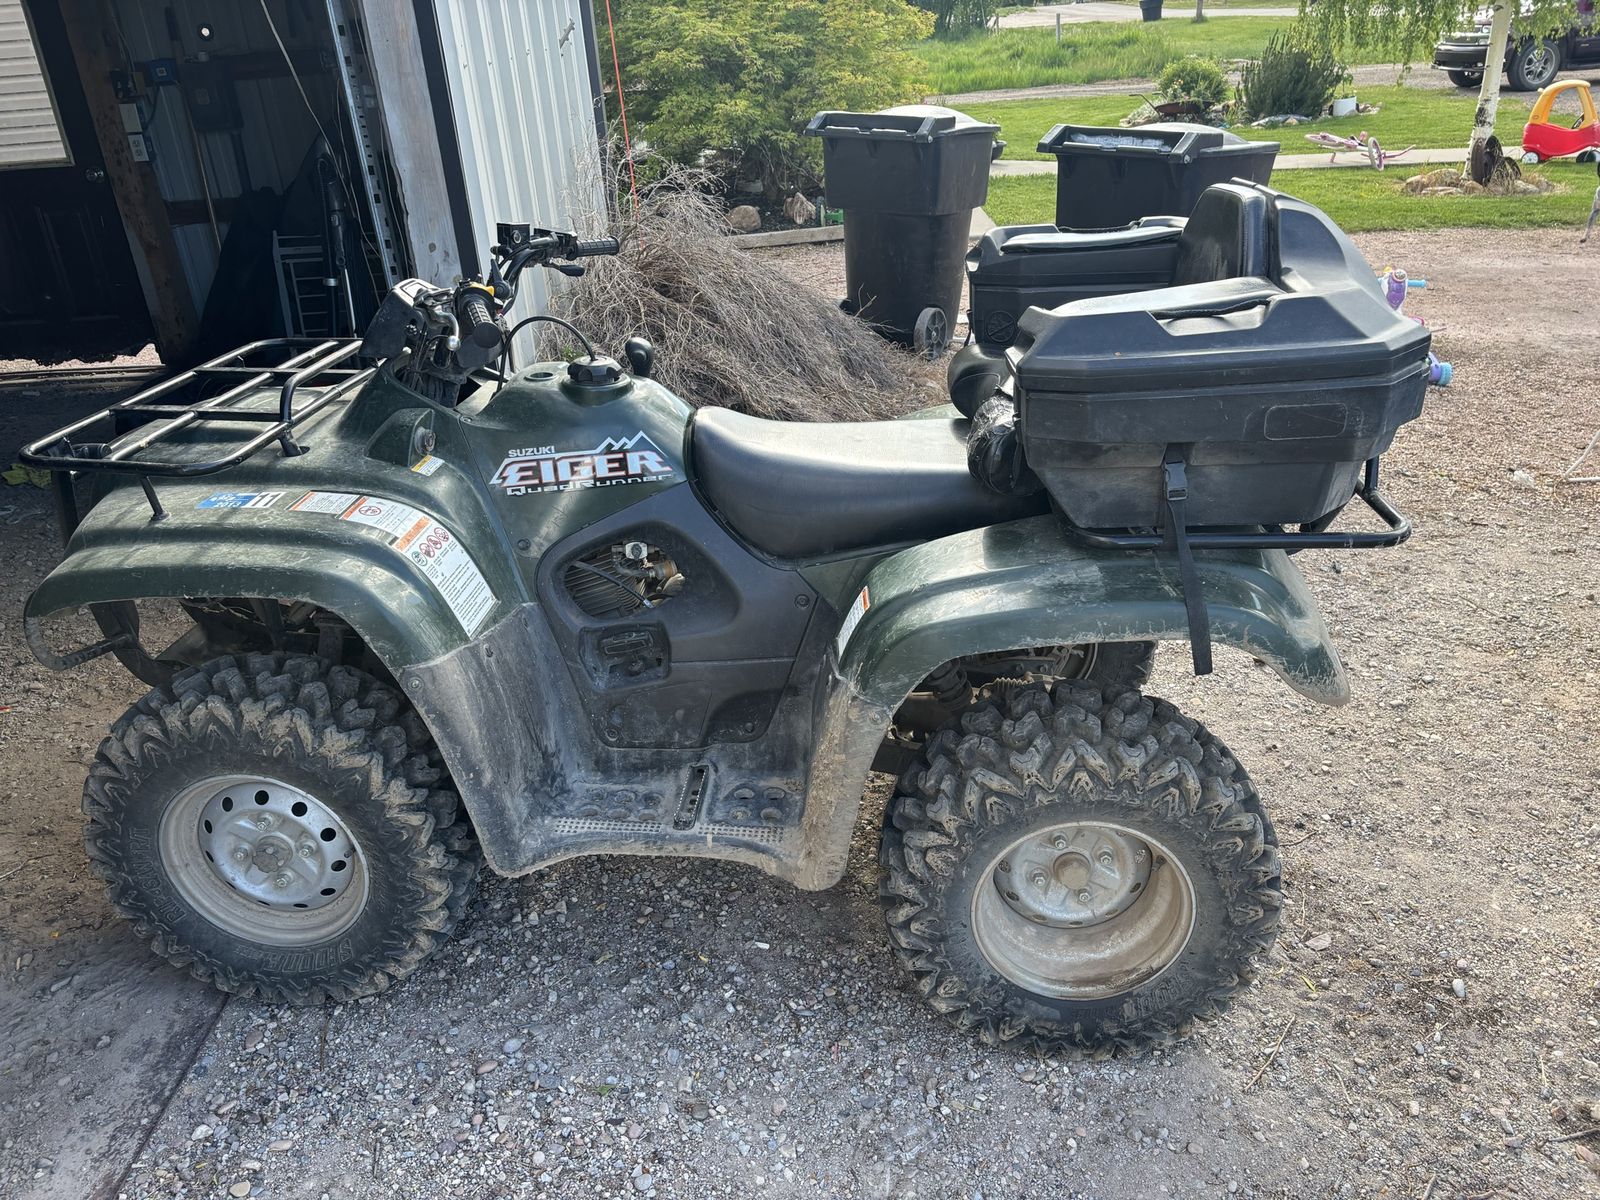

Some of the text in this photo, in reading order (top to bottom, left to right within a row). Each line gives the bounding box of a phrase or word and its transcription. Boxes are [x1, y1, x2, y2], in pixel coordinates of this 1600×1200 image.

[508, 446, 555, 458] SUZUKI
[499, 450, 672, 488] EIGER
[506, 474, 673, 496] QuadRunner
